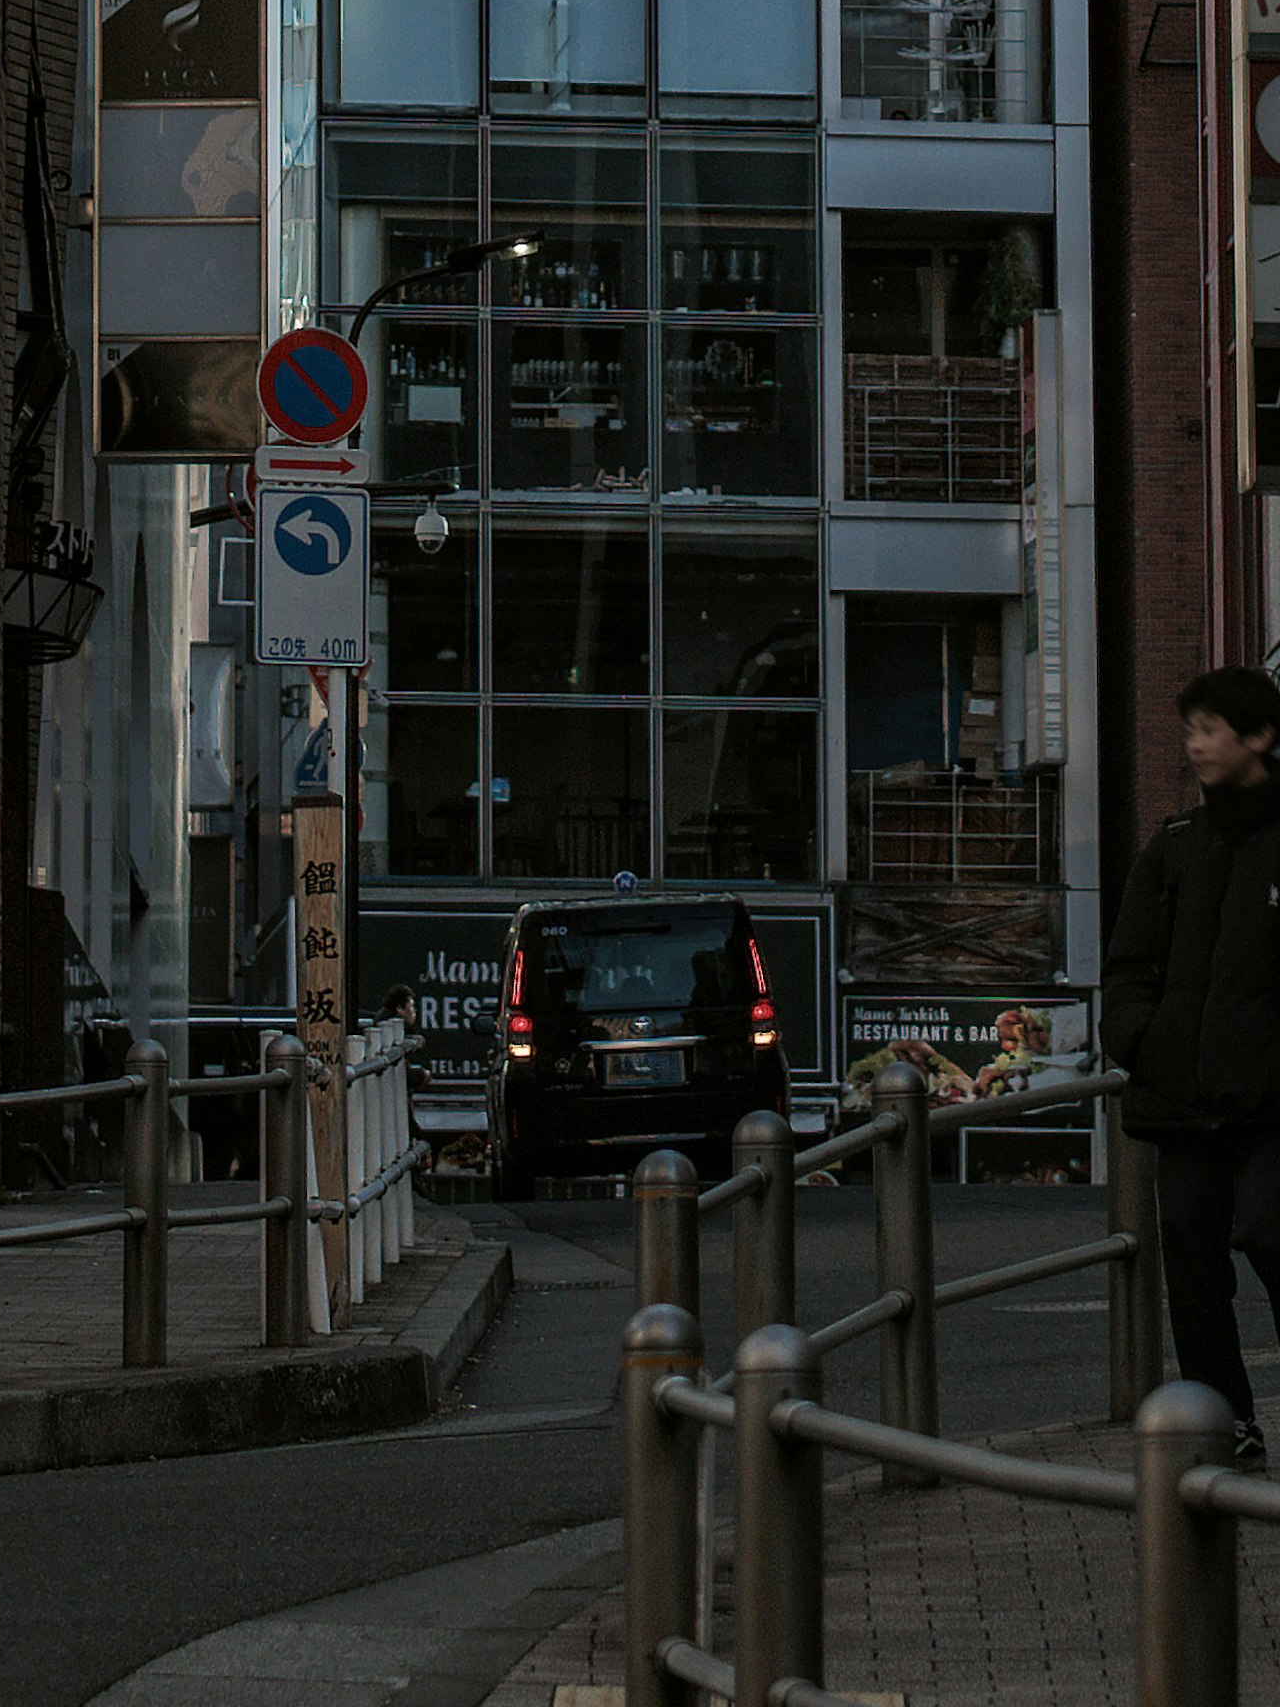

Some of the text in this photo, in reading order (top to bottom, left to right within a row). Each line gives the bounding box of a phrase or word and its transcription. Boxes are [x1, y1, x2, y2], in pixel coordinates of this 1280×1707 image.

[107, 348, 120, 361] B1
[269, 637, 357, 659] この先 40m
[853, 1023, 999, 1042] RESTAURANT & BAR
